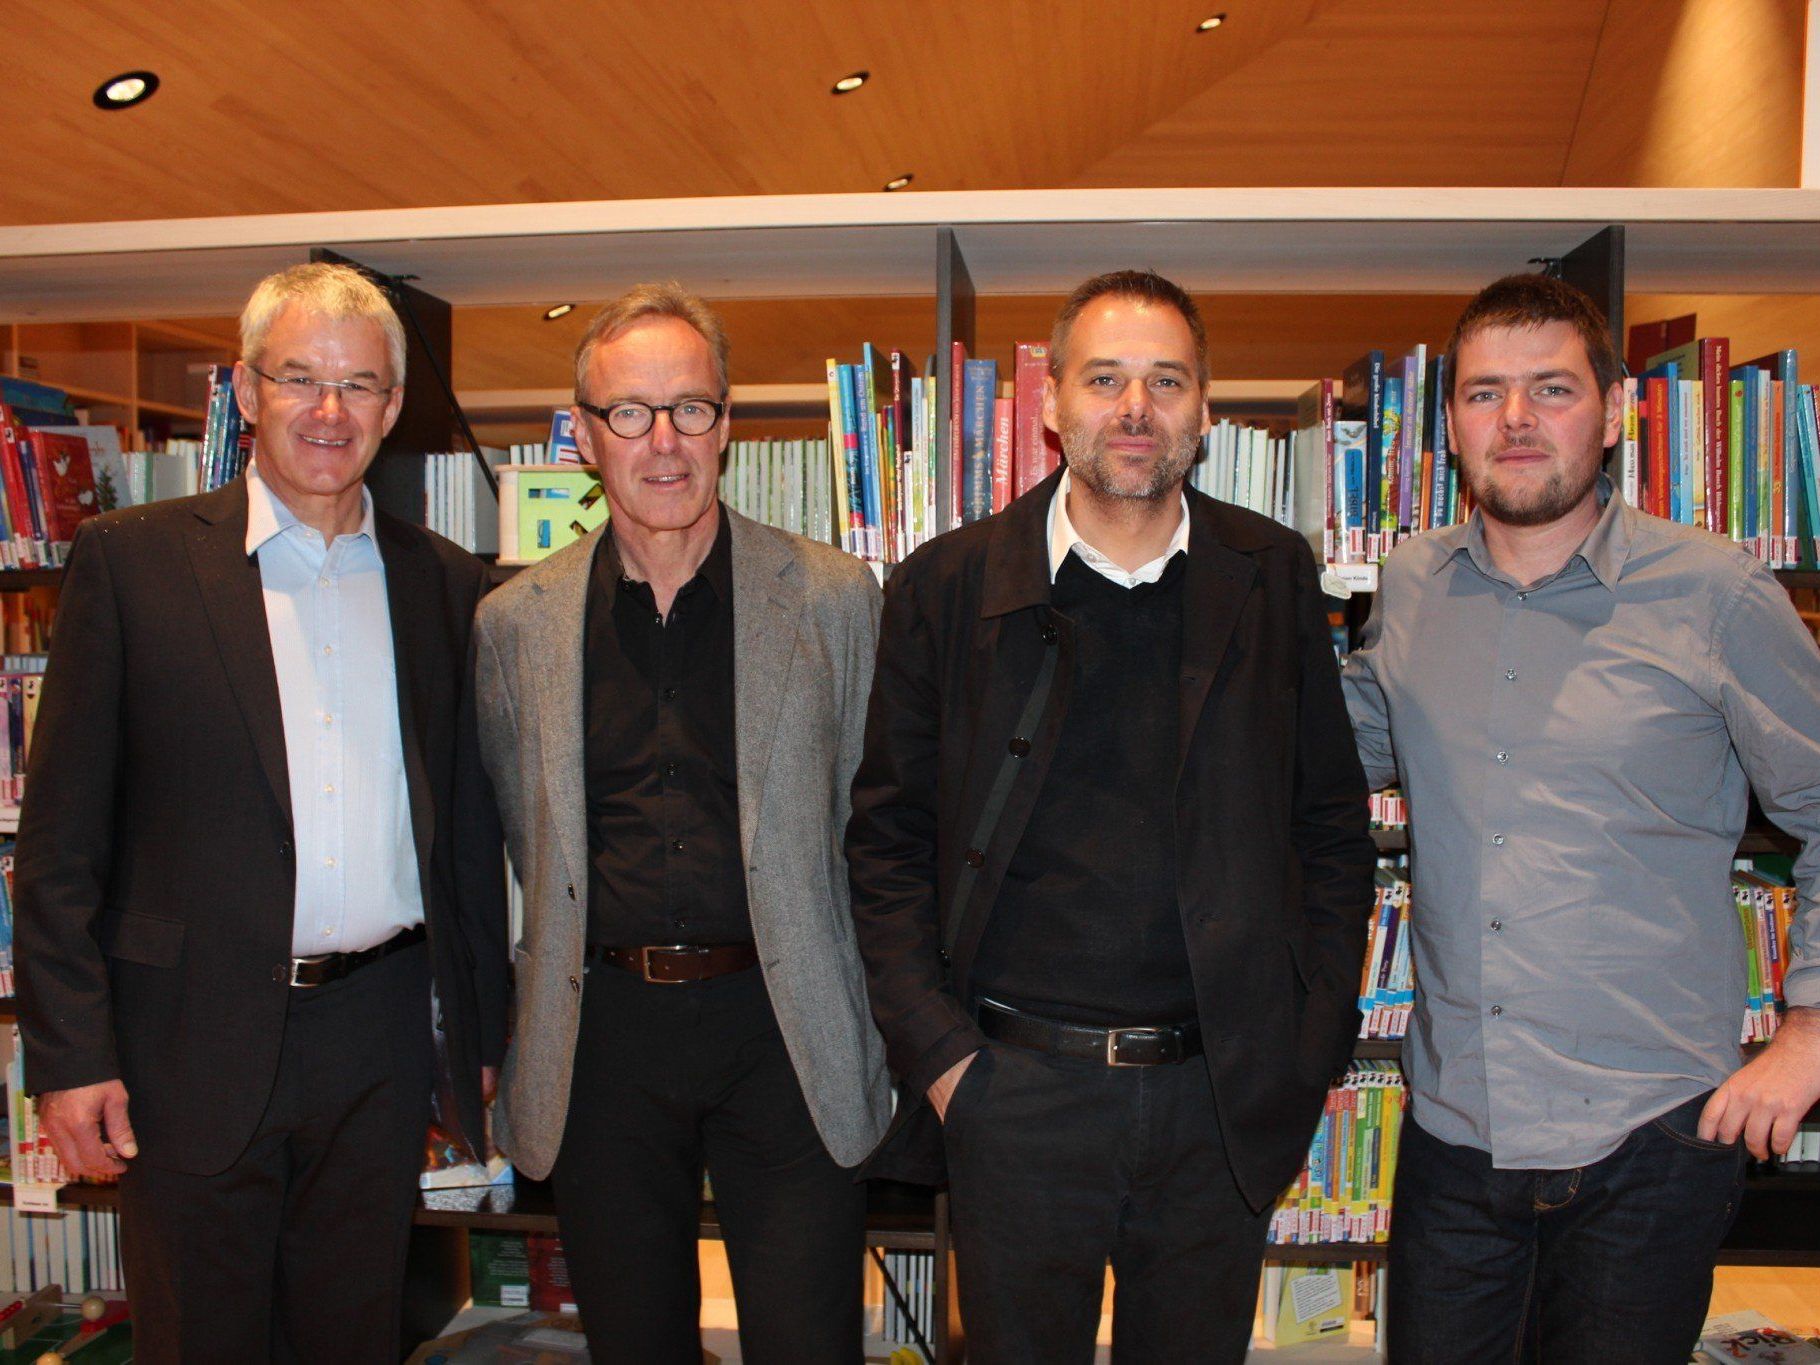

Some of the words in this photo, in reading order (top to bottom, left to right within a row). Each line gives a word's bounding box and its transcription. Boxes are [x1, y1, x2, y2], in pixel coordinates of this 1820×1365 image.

[972, 385, 985, 448] MÄRCHEN
[1404, 426, 1413, 449] Immer
[996, 416, 1009, 486] Märchen
[973, 462, 985, 515] GRIMMS
